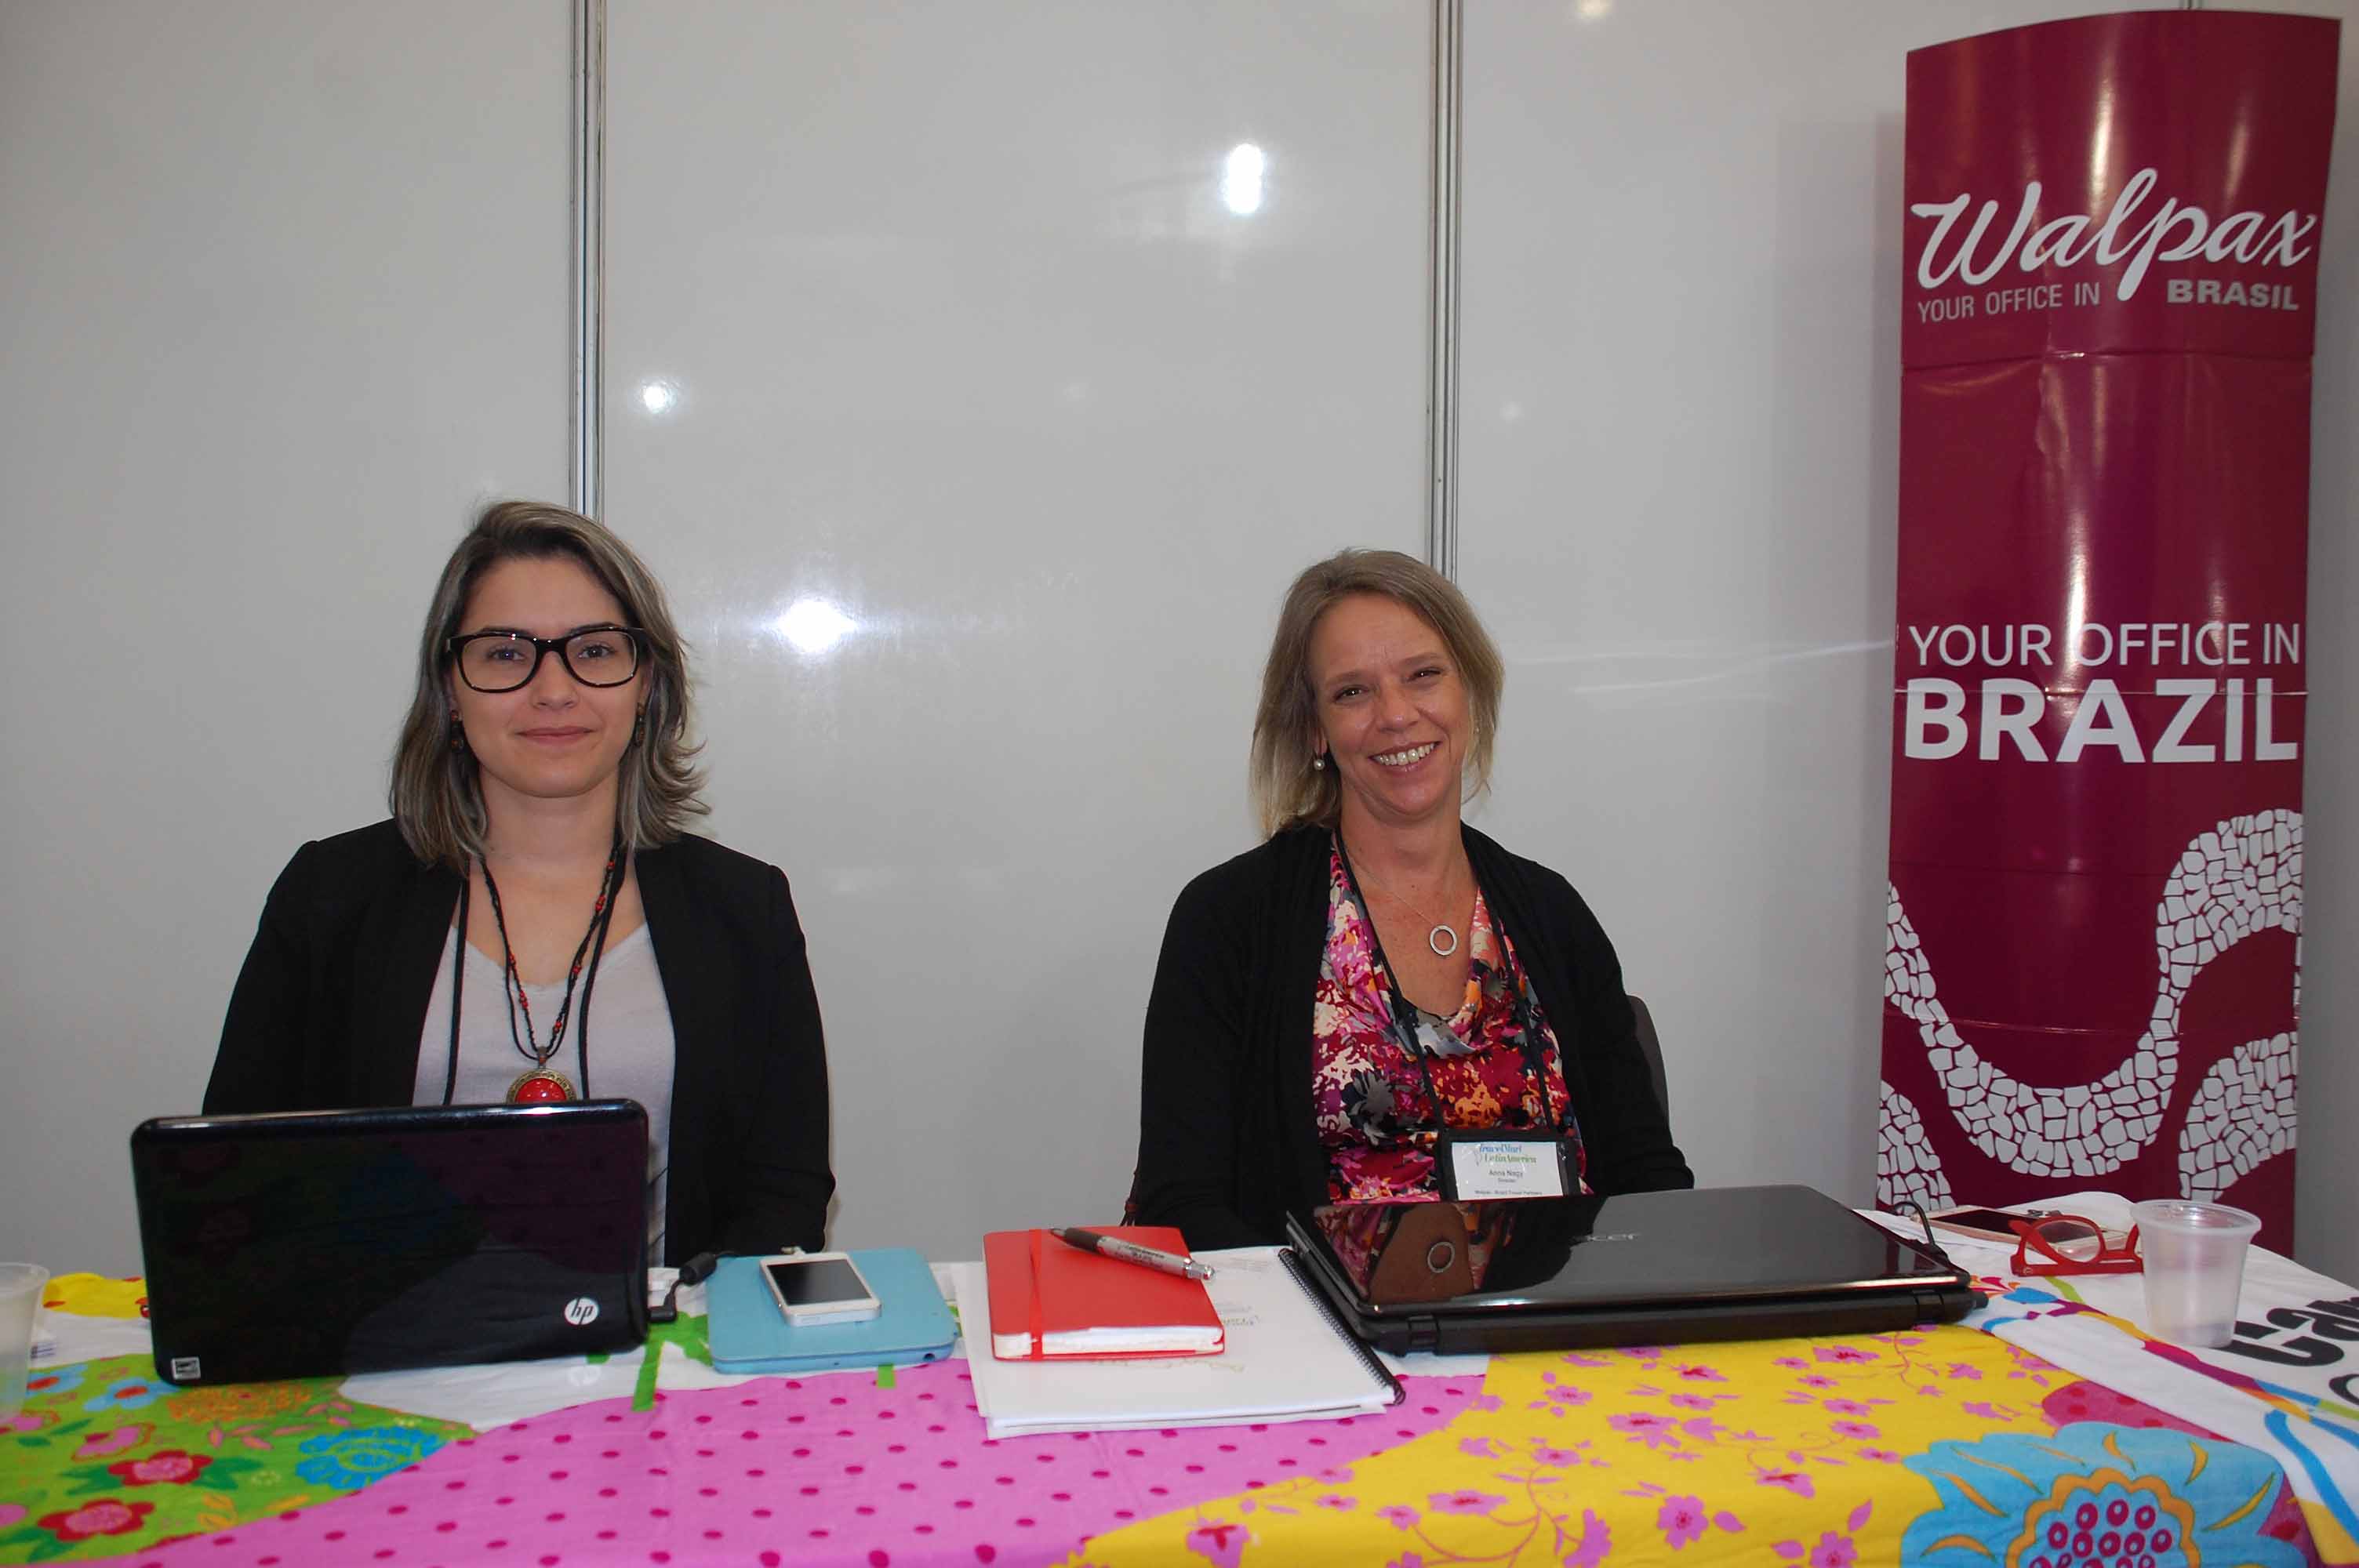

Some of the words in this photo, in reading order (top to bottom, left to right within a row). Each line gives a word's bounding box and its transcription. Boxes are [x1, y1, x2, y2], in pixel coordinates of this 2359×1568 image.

[1910, 167, 2317, 302] Walpax
[1917, 295, 1975, 324] YOUR
[1985, 284, 2063, 315] OFFICE
[2074, 281, 2101, 307] IN
[2167, 278, 2300, 310] BRASIL
[1908, 623, 2054, 666] YOUR
[2076, 622, 2250, 666] OFFICE
[2263, 622, 2300, 665] IN
[1904, 677, 2299, 764] BRAZIL
[570, 1297, 594, 1325] hp
